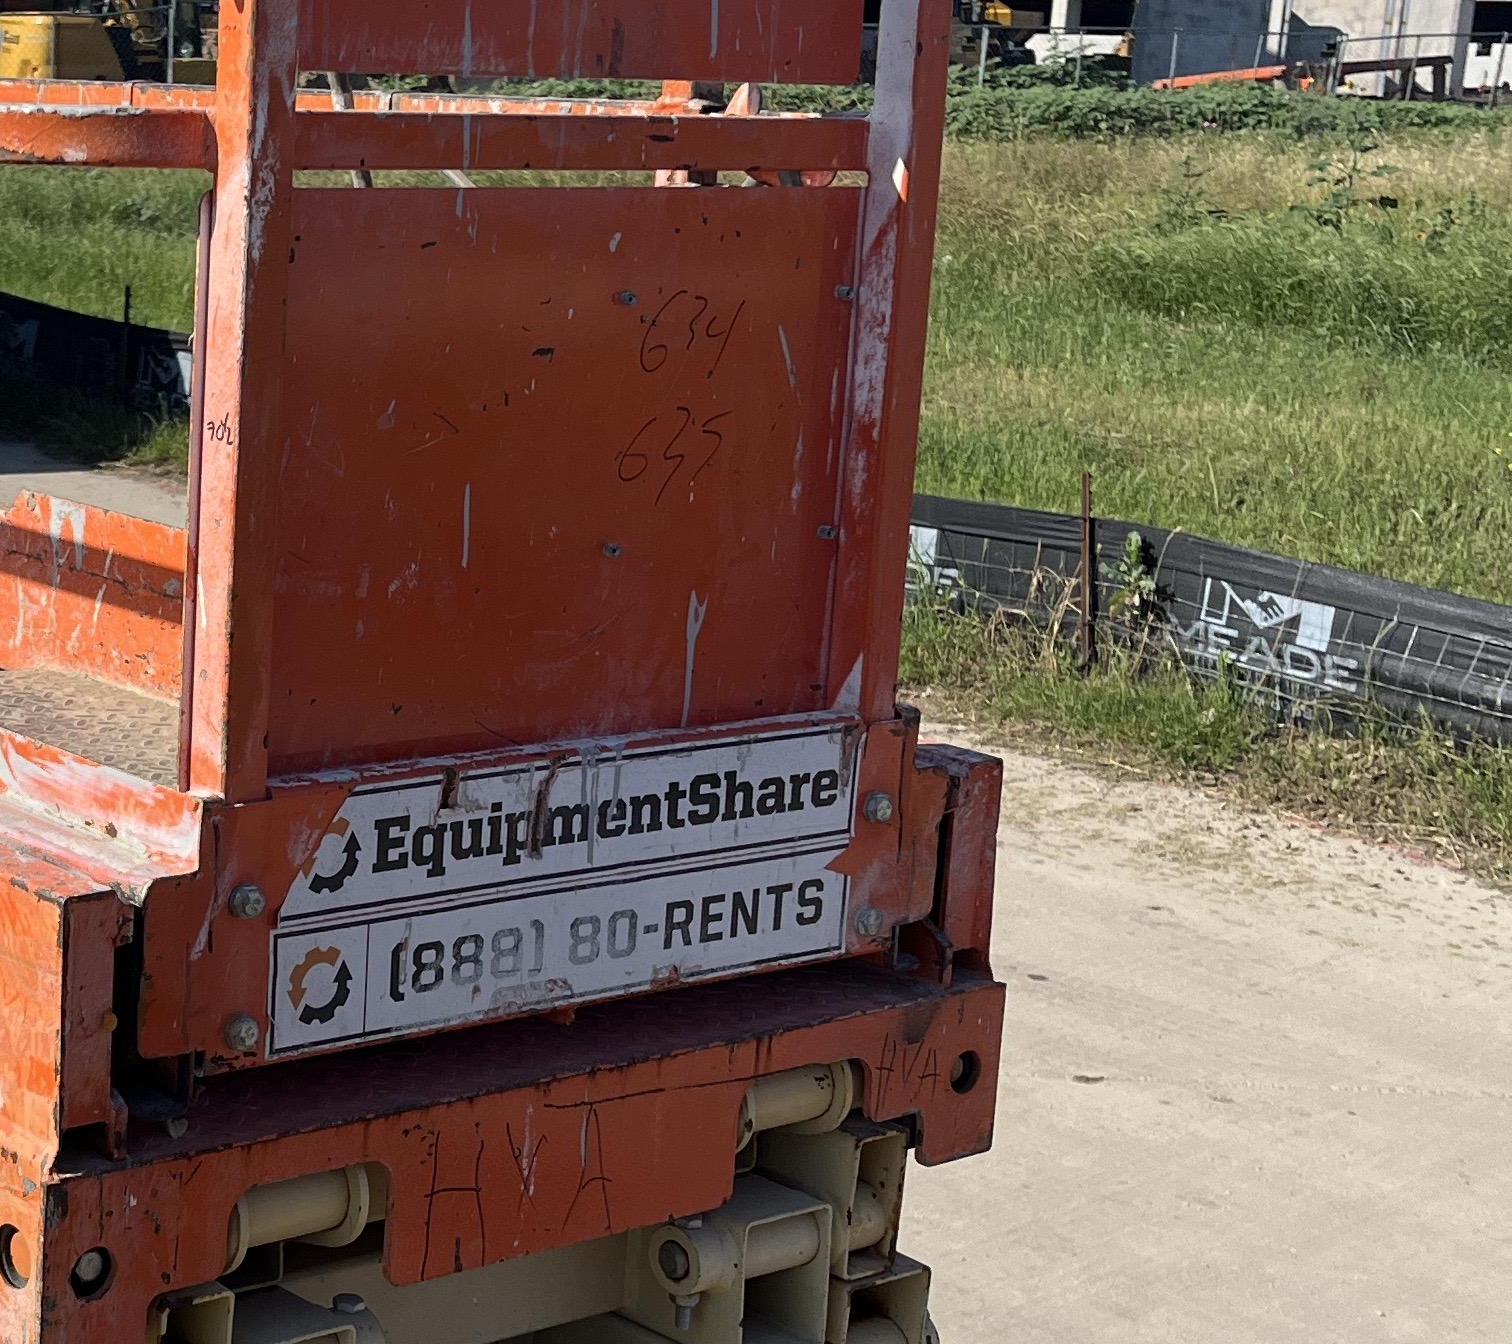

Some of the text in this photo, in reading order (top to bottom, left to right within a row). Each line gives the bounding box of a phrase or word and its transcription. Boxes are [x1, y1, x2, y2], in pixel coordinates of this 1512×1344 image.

[640, 289, 747, 379] 634
[371, 768, 839, 879] EquipmentShare
[388, 877, 825, 1003] (888) 80-RENTS
